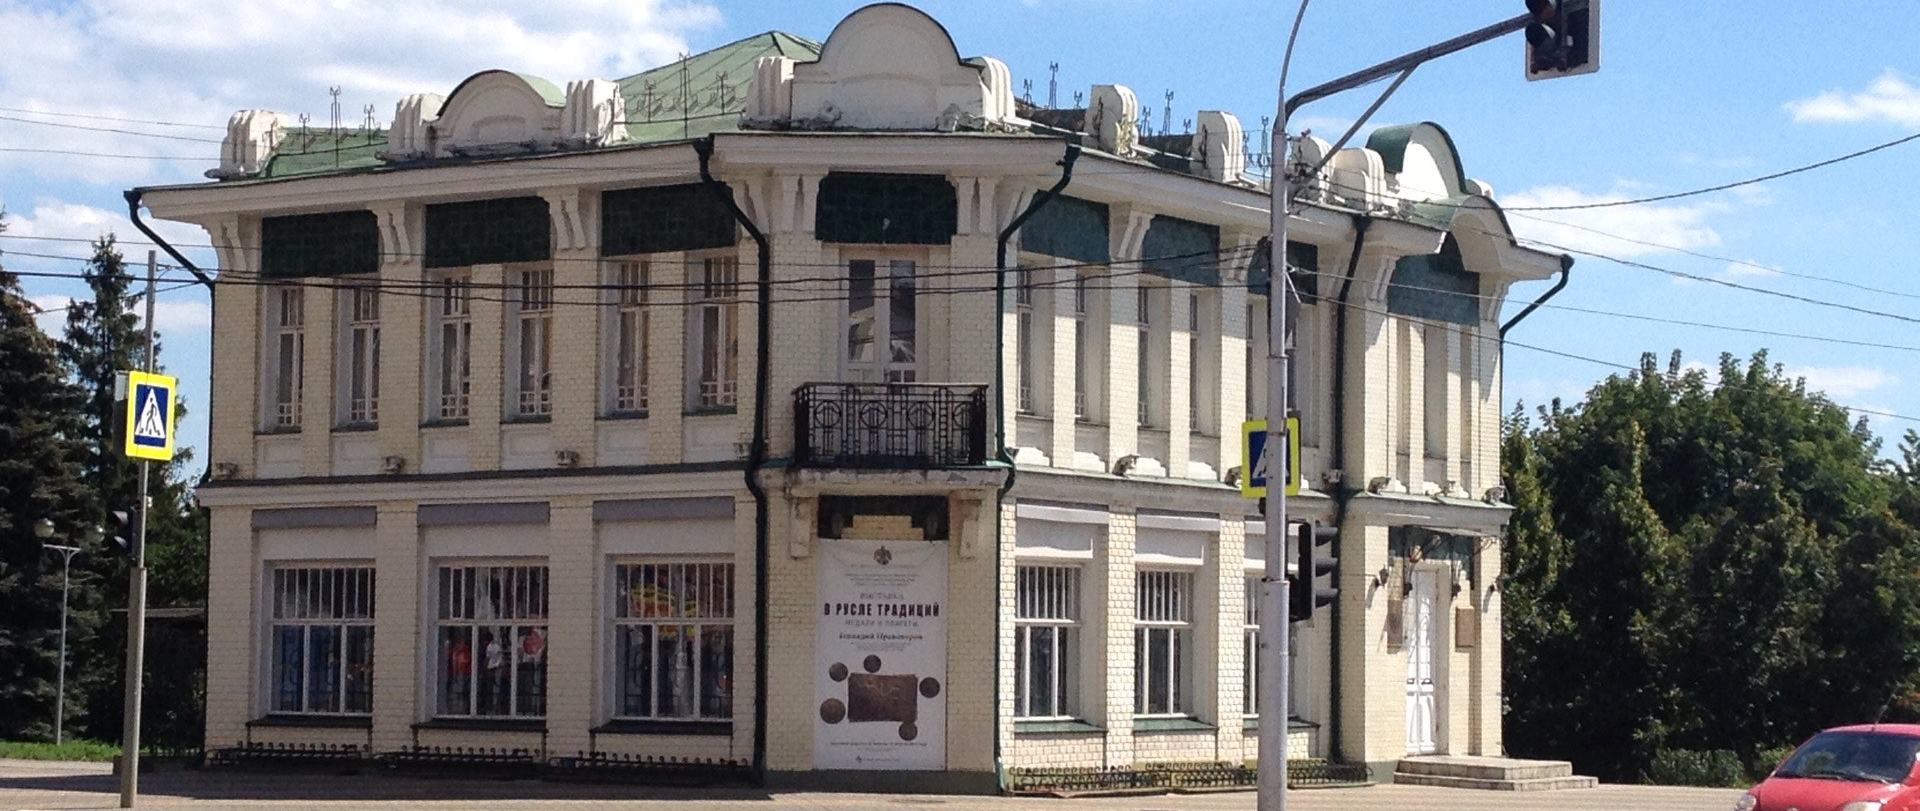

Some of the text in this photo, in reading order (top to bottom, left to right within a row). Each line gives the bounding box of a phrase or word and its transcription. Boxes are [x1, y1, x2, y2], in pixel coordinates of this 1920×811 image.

[824, 601, 940, 619] В РУСЛЕ ТРАДИЦИЙ
